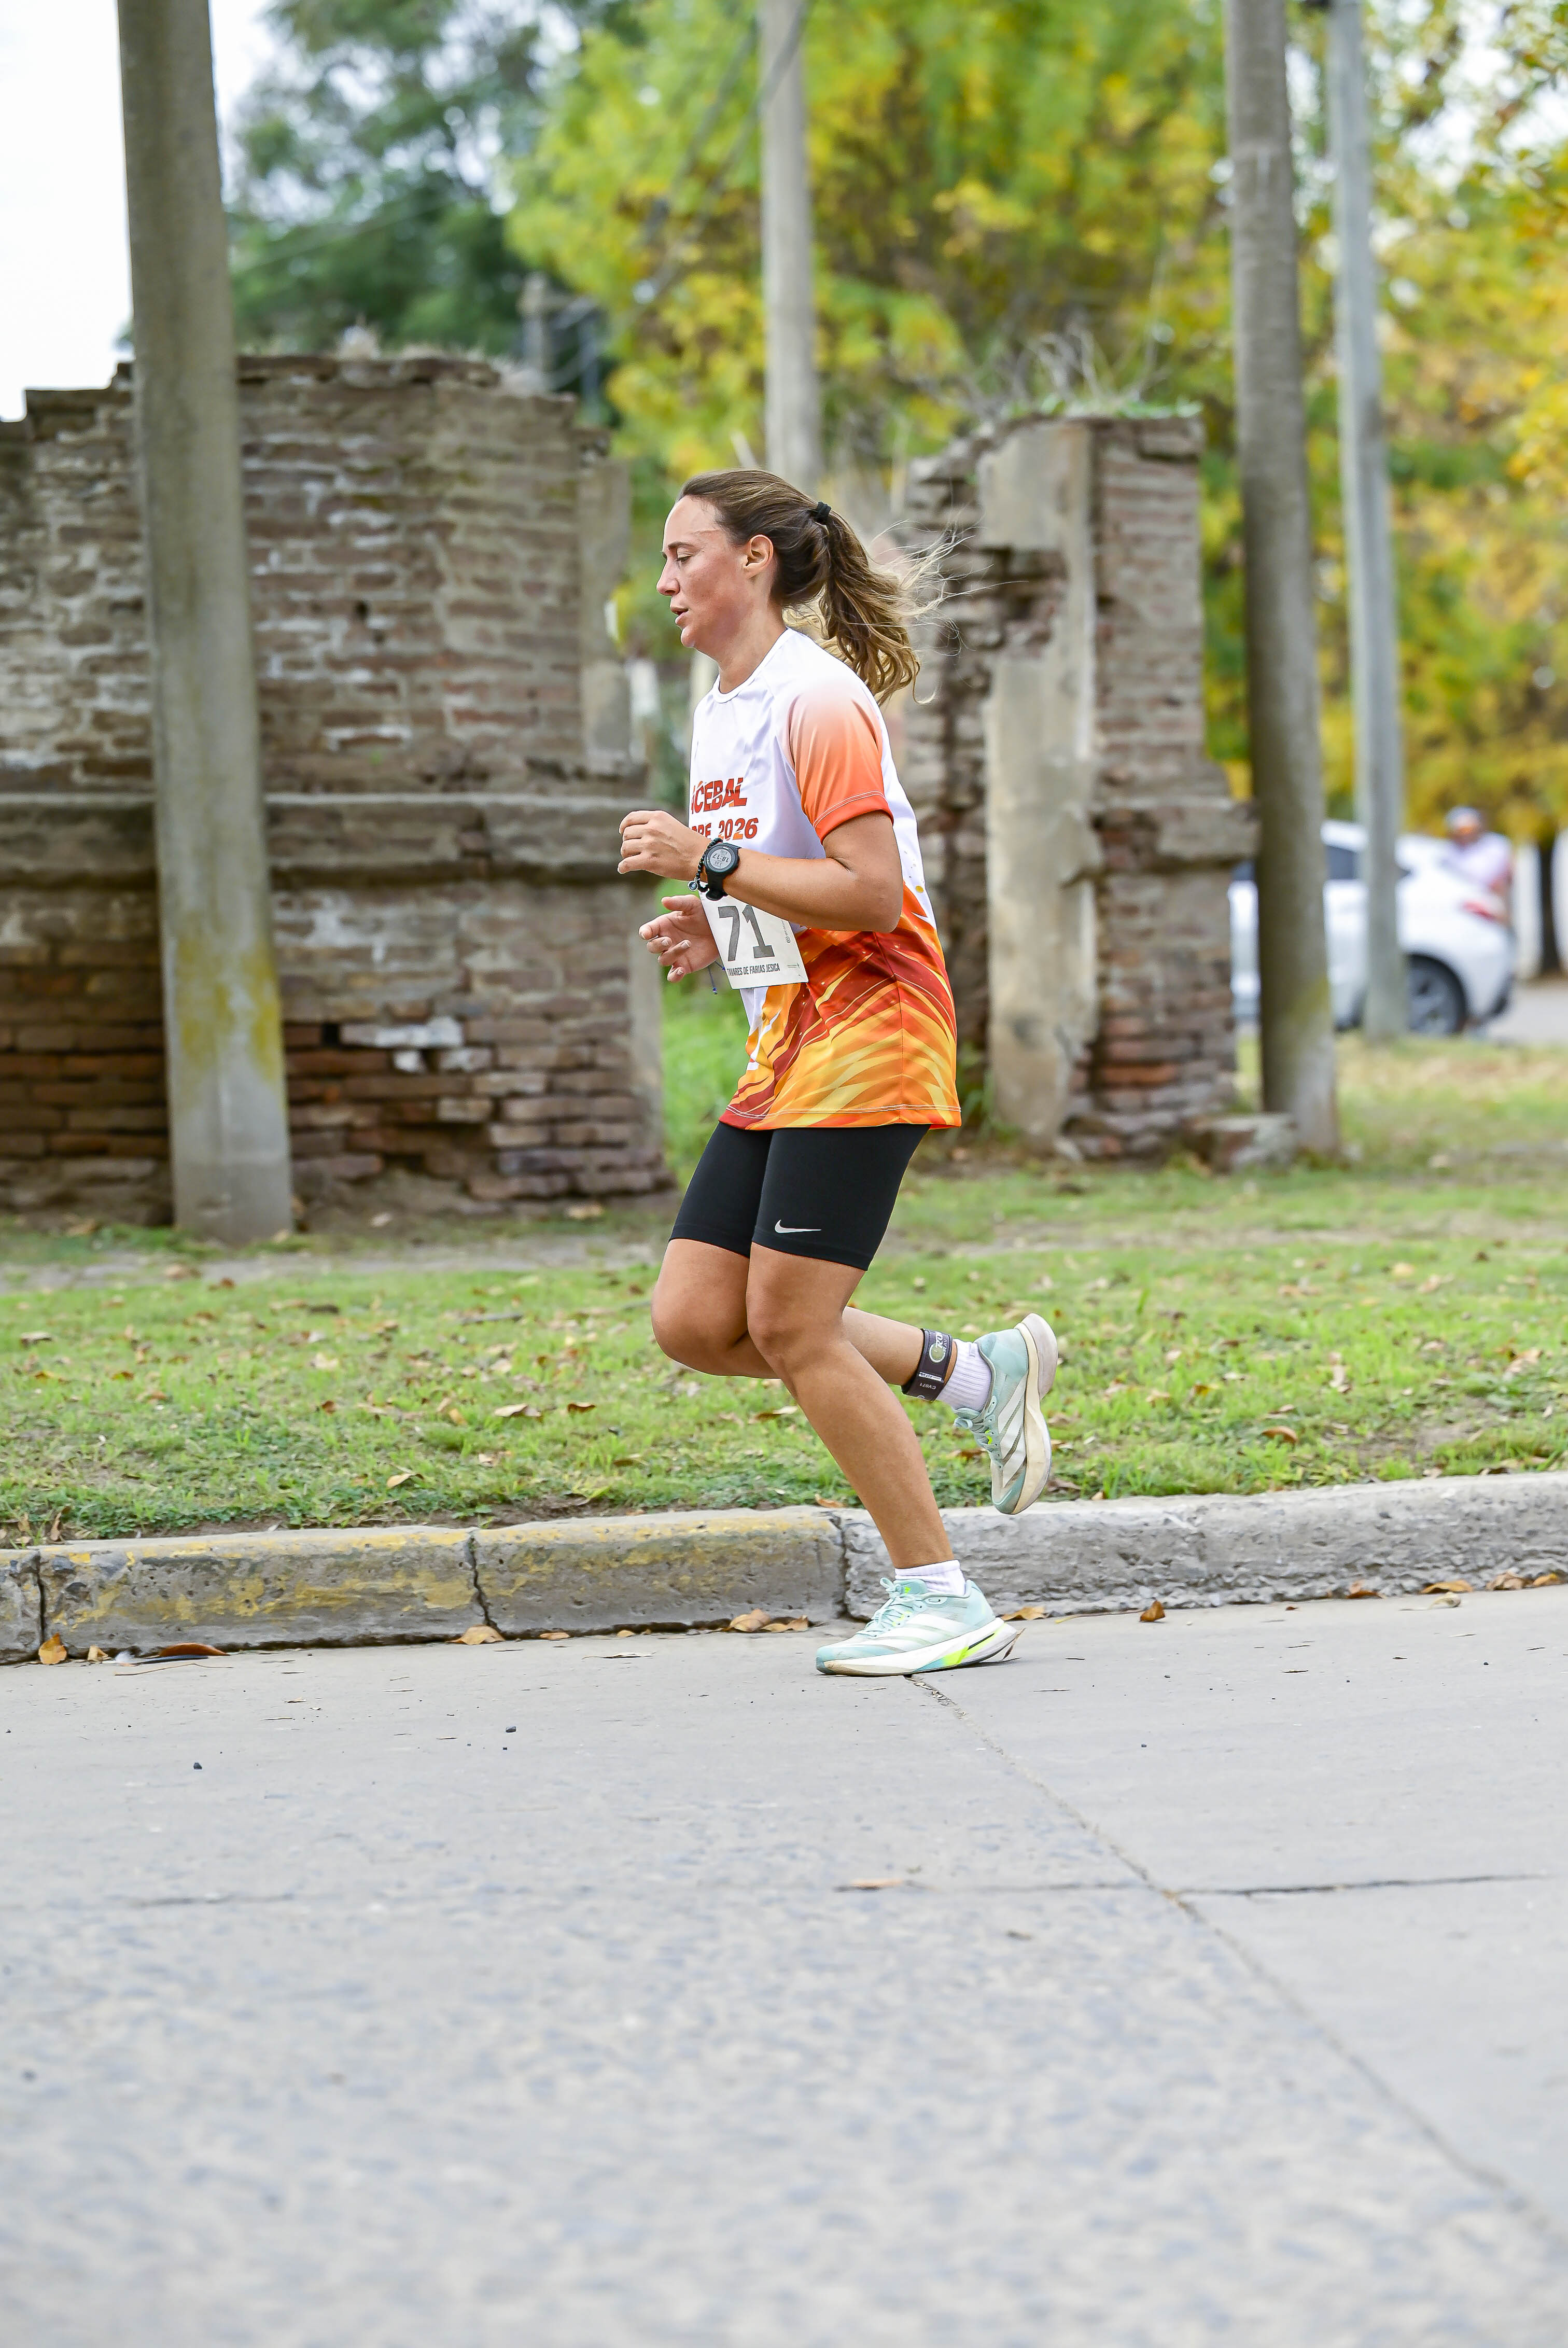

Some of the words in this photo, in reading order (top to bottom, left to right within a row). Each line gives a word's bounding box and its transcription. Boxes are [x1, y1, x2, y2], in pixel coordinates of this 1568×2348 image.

[691, 777, 747, 814] CEBAL
[718, 818, 759, 841] 2026
[712, 853, 729, 863] 18:17
[718, 905, 775, 961] 71
[743, 967, 749, 975] DE
[750, 965, 765, 974] FARIAS
[766, 963, 780, 973] JESICA
